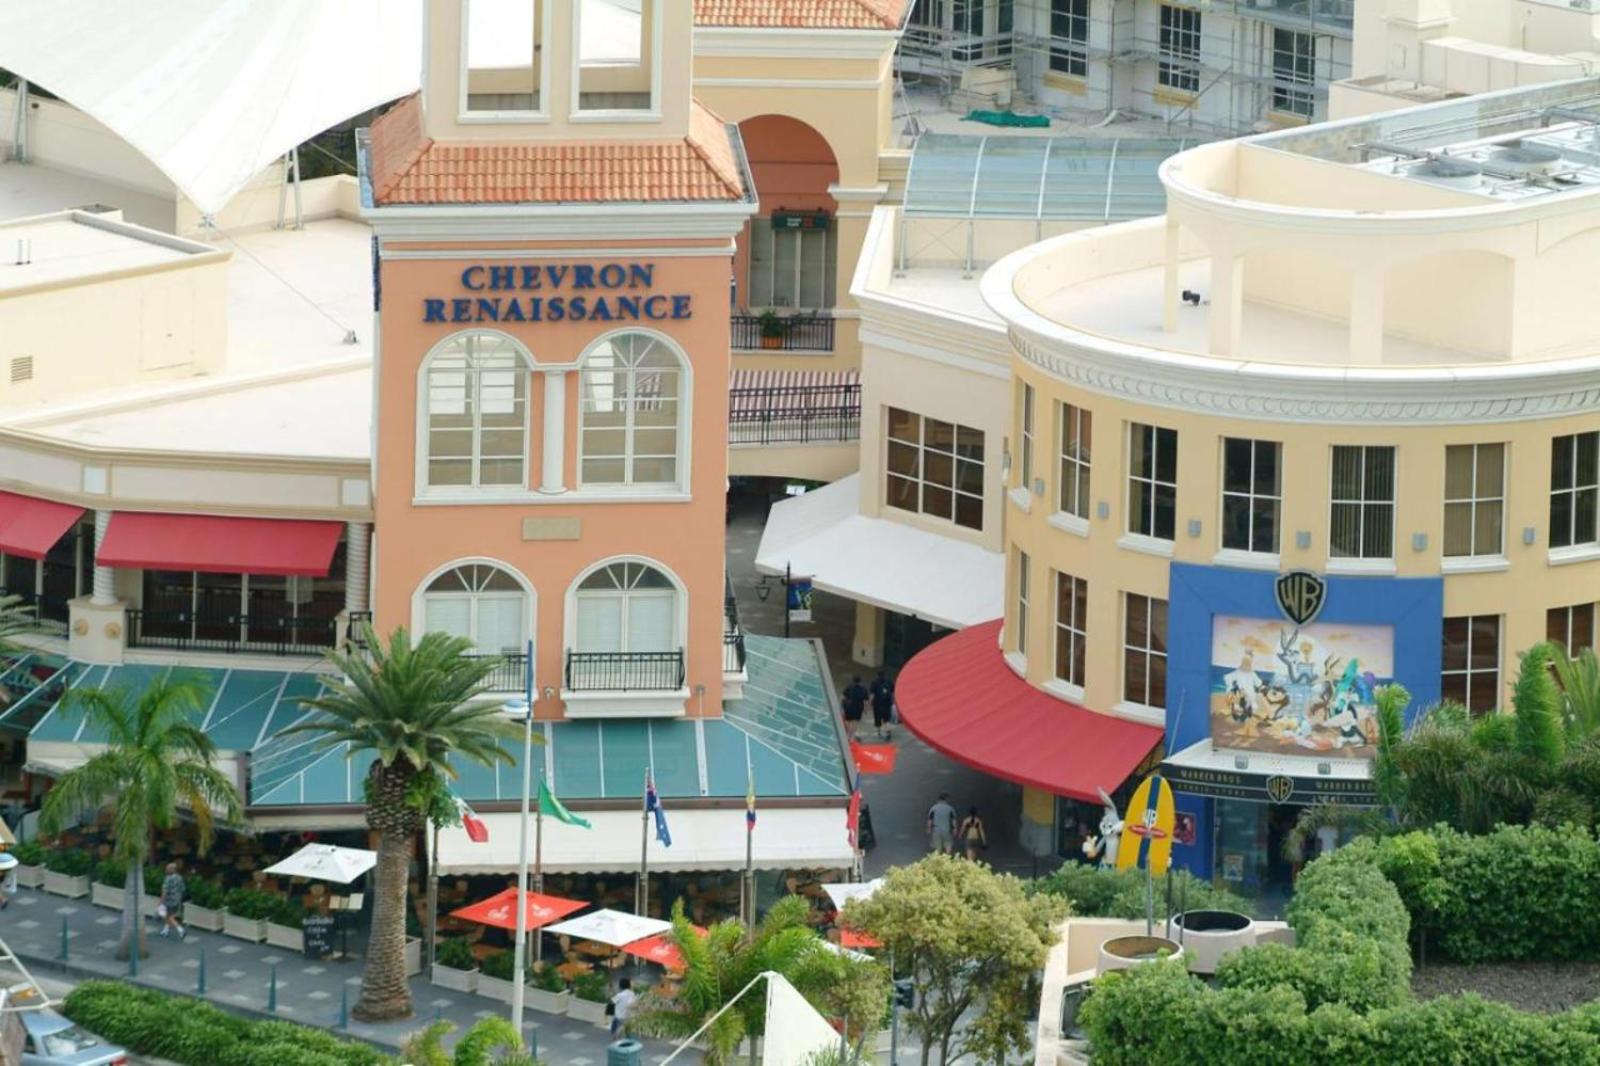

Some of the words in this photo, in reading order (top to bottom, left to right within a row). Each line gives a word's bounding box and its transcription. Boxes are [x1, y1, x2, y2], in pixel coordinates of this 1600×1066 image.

[461, 264, 655, 290] CHEVRON
[423, 296, 692, 323] RENAISSANCE
[1278, 574, 1322, 622] WB
[1268, 776, 1291, 801] WB
